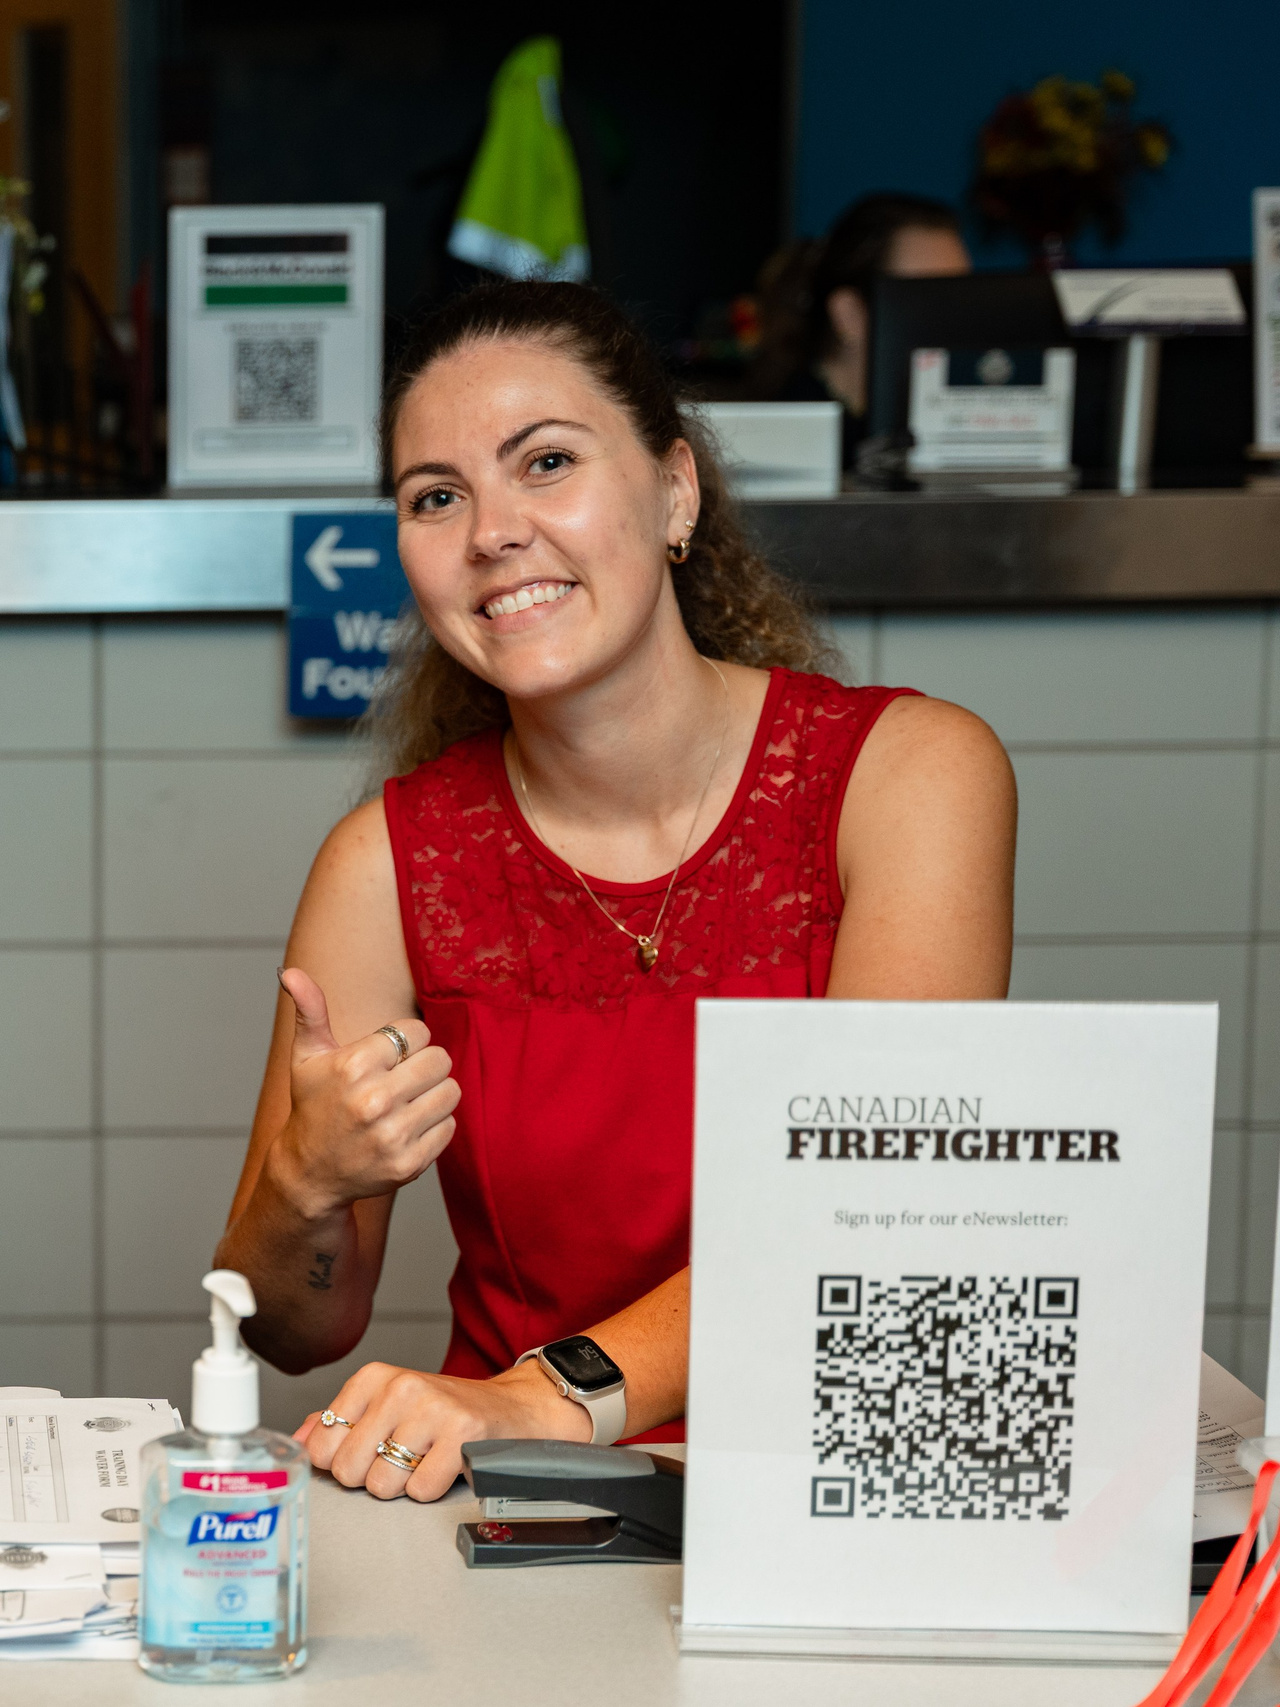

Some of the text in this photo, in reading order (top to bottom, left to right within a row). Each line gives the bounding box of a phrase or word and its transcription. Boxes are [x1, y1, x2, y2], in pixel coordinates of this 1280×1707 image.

[302, 657, 388, 700] Fou
[787, 1096, 982, 1124] CANADIAN
[786, 1128, 1121, 1162] FIREFIGHTER
[833, 1210, 1068, 1230] Sign up for our eNewsletter:
[95, 1449, 112, 1488] WAIVER FORM
[112, 1450, 130, 1488] TRAINING DAY
[198, 1549, 268, 1560] ADVANCED
